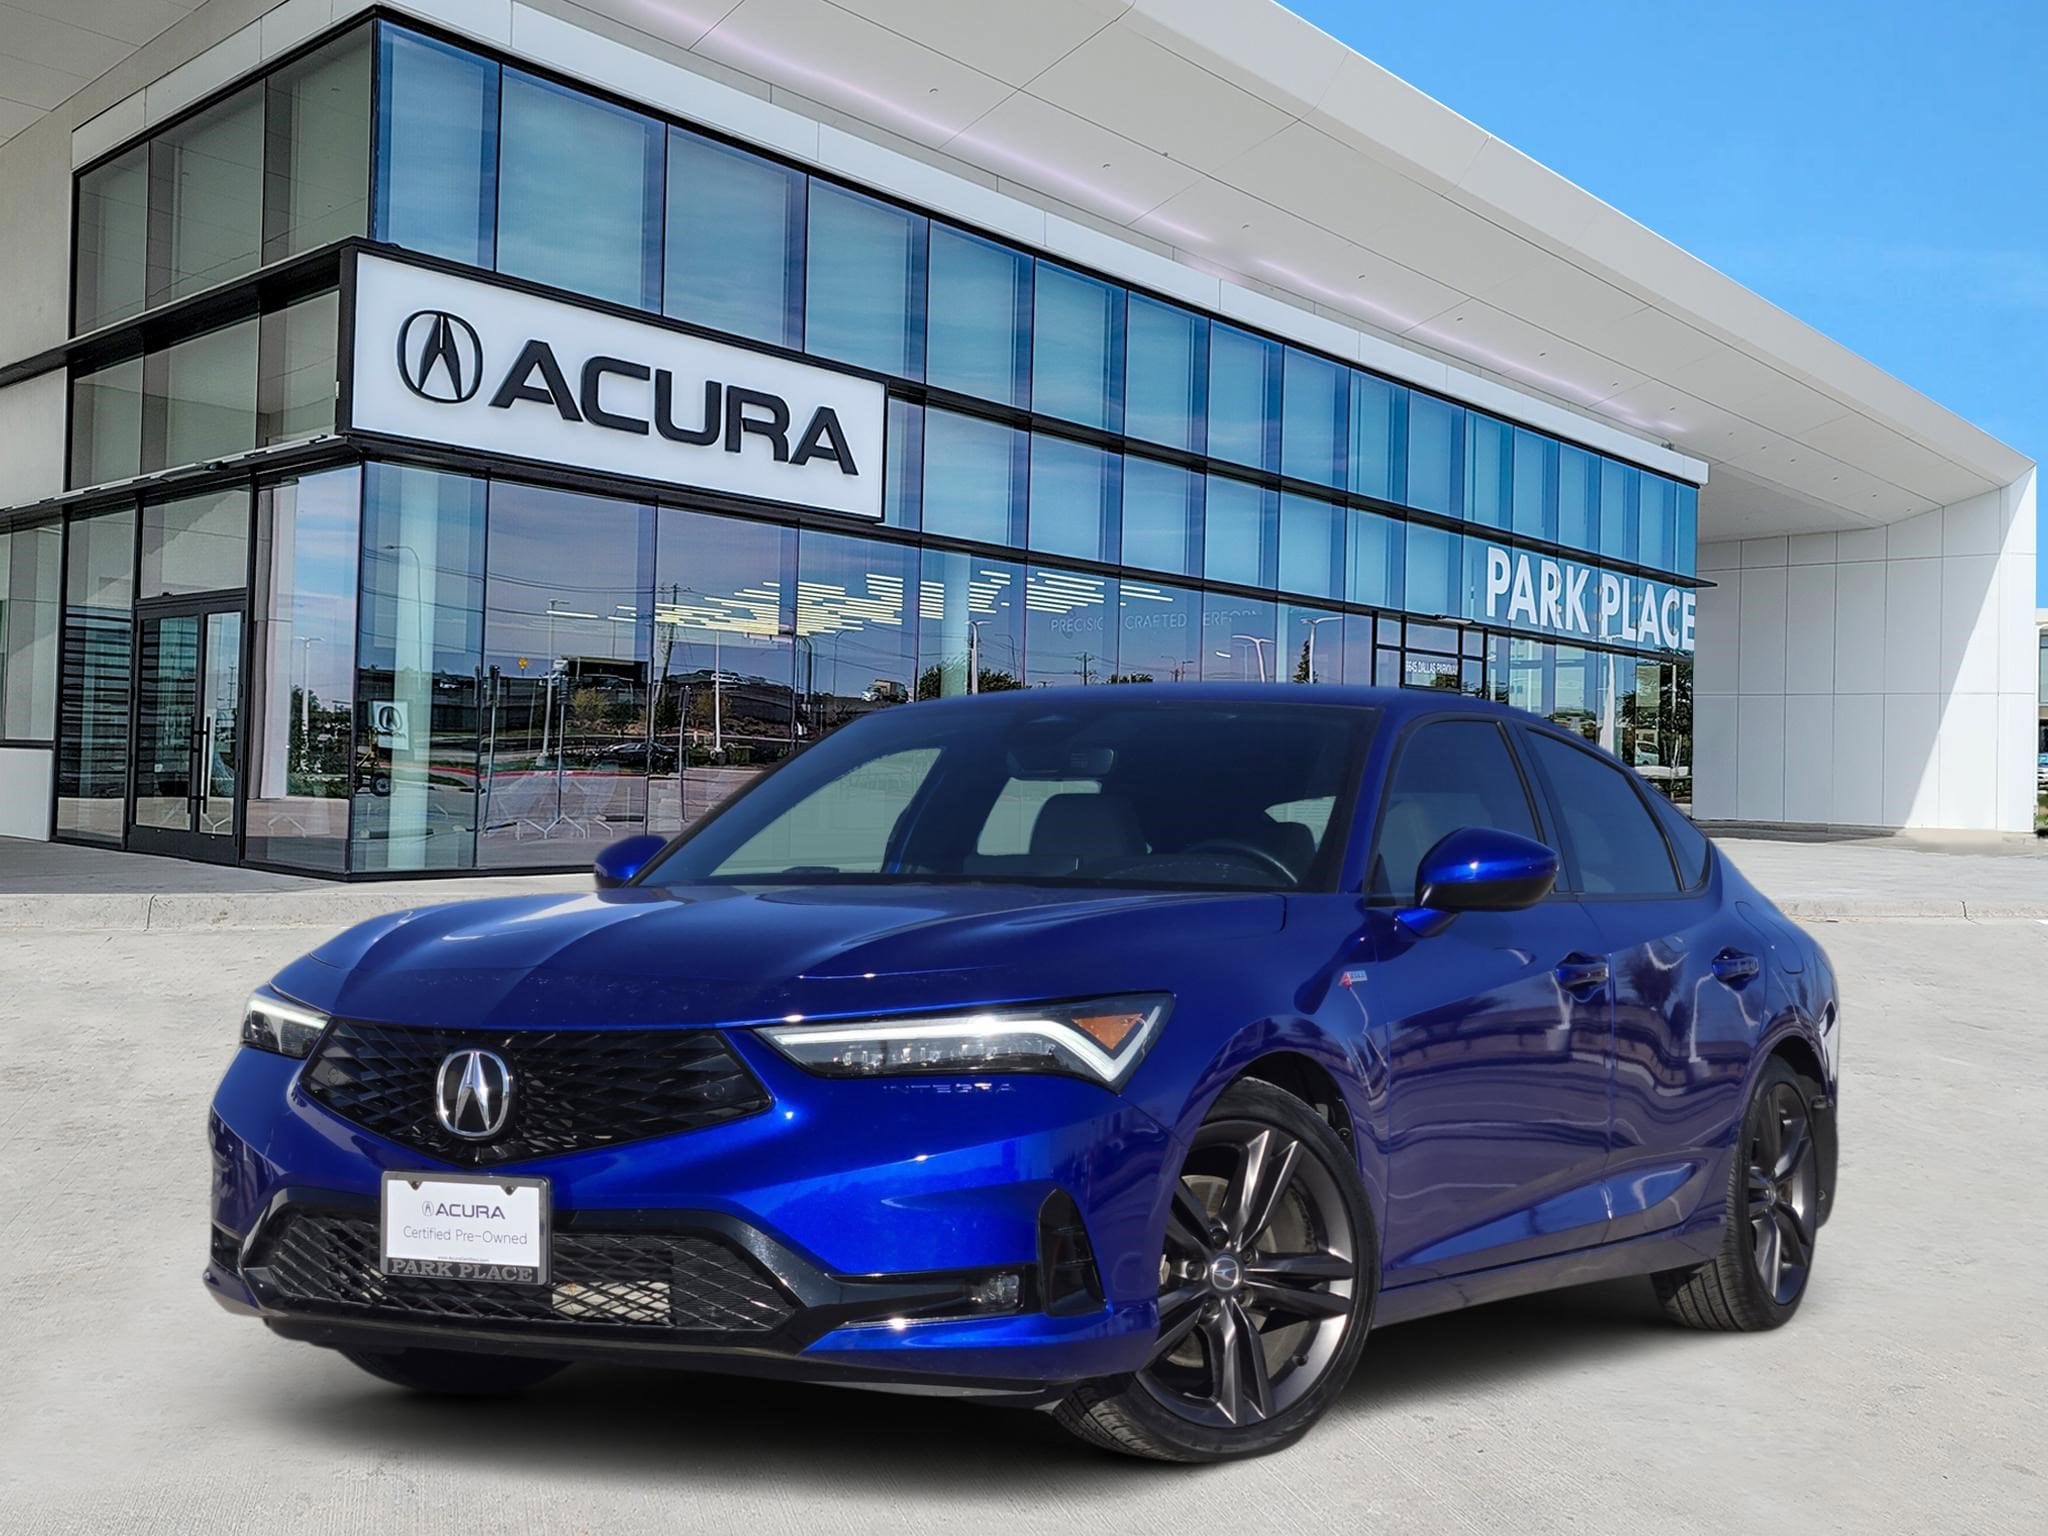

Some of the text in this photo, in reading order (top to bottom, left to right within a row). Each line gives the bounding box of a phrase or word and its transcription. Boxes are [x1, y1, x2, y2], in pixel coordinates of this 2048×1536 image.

[488, 339, 859, 476] ACURA
[1486, 546, 1696, 651] PARK PLACE
[1125, 613, 1187, 630] CRAFTED
[435, 1203, 506, 1220] ACURA
[403, 1226, 528, 1245] Certified Pre-Owned
[391, 1259, 454, 1278] PARK
[459, 1263, 533, 1282] PLACE
